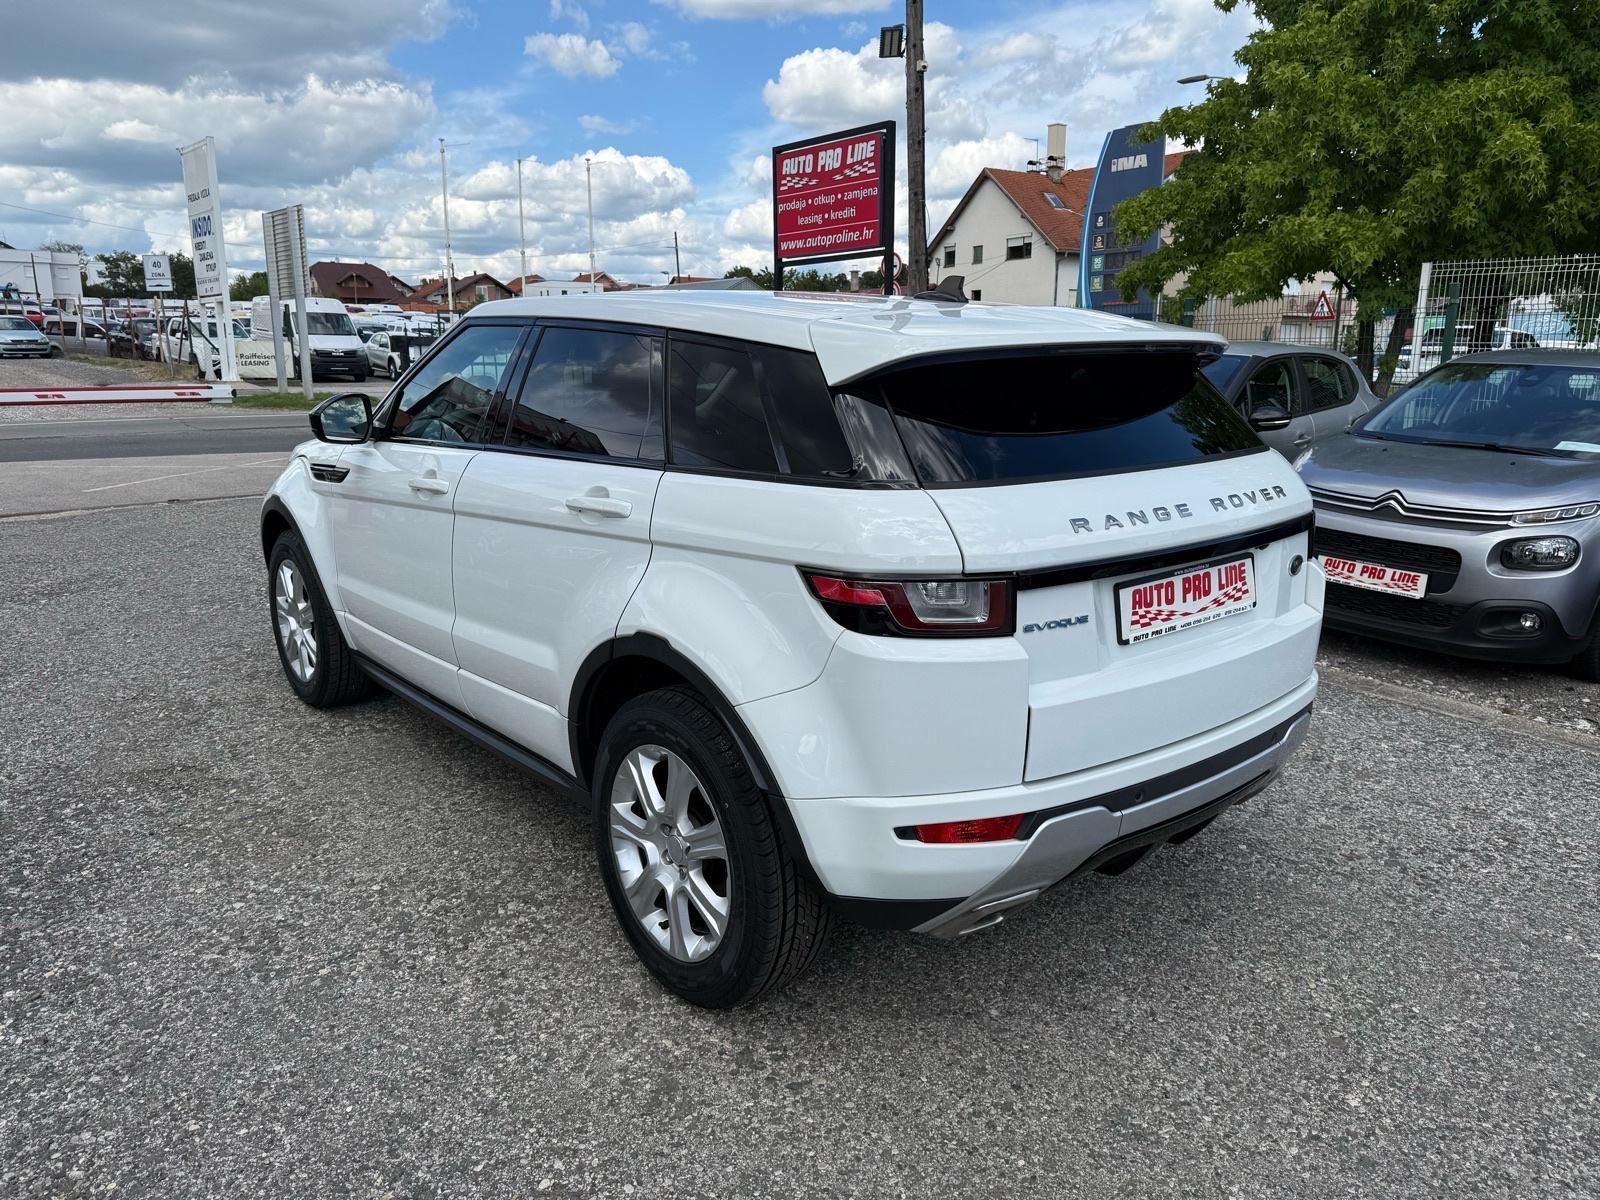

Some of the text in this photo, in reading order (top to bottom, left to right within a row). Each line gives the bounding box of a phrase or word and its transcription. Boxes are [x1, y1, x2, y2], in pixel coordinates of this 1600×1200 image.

[782, 140, 876, 175] AUTO PRO LINE
[1111, 153, 1148, 173] INA
[778, 186, 878, 213] prodaja otkup zamjena
[797, 206, 856, 225] leasing krediti
[780, 226, 874, 250] www.autoproline.hr
[152, 260, 162, 268] 40
[239, 352, 276, 360] Raiffeisen
[1069, 485, 1288, 534] RANGE ROVER
[1324, 558, 1357, 574] AUTO
[1360, 565, 1387, 580] PRO
[1390, 571, 1421, 584] LINE
[1131, 562, 1246, 611] AUTO PRO LINE
[1022, 614, 1089, 633] EVOQUE
[1133, 632, 1150, 642] AUTO
[1151, 629, 1163, 637] PRO
[1164, 625, 1177, 633] LINE
